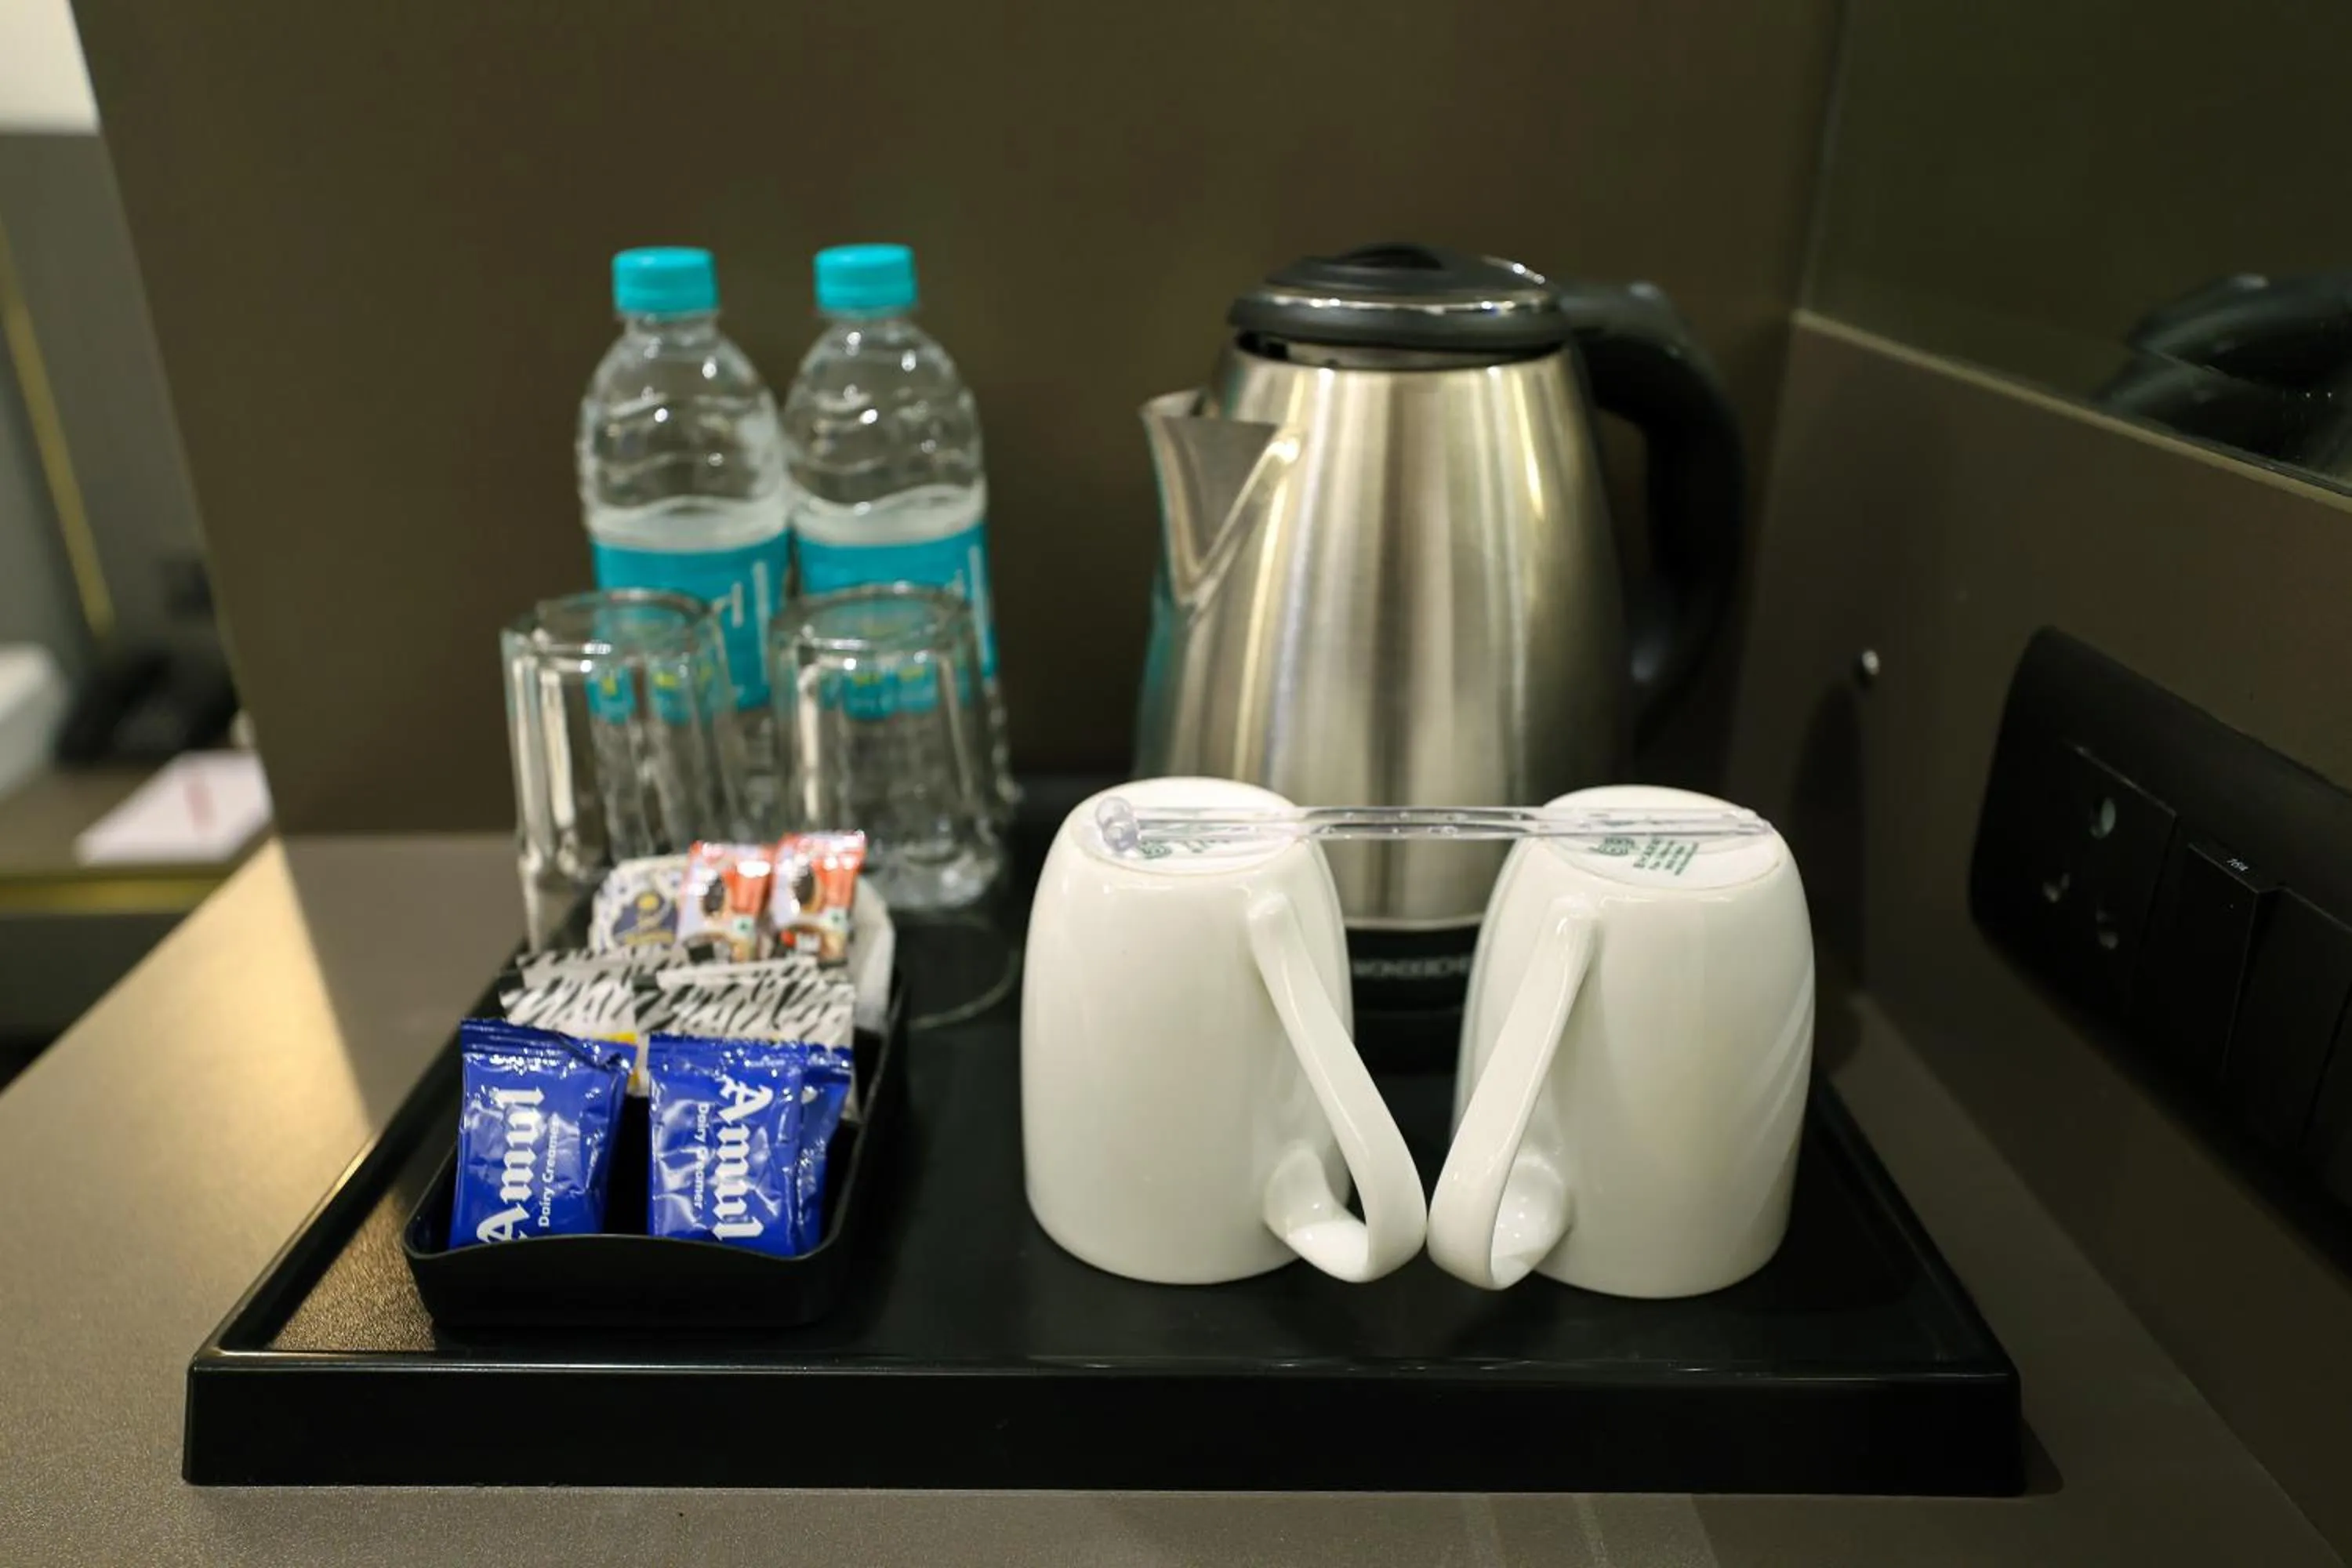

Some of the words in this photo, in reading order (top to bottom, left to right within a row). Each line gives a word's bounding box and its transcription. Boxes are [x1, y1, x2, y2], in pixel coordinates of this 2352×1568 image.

[695, 1102, 710, 1142] Dairy
[477, 1087, 544, 1243] Amul
[695, 1145, 709, 1210] Ceamer
[712, 1074, 773, 1241] Amul
[538, 1186, 555, 1228] Dairy
